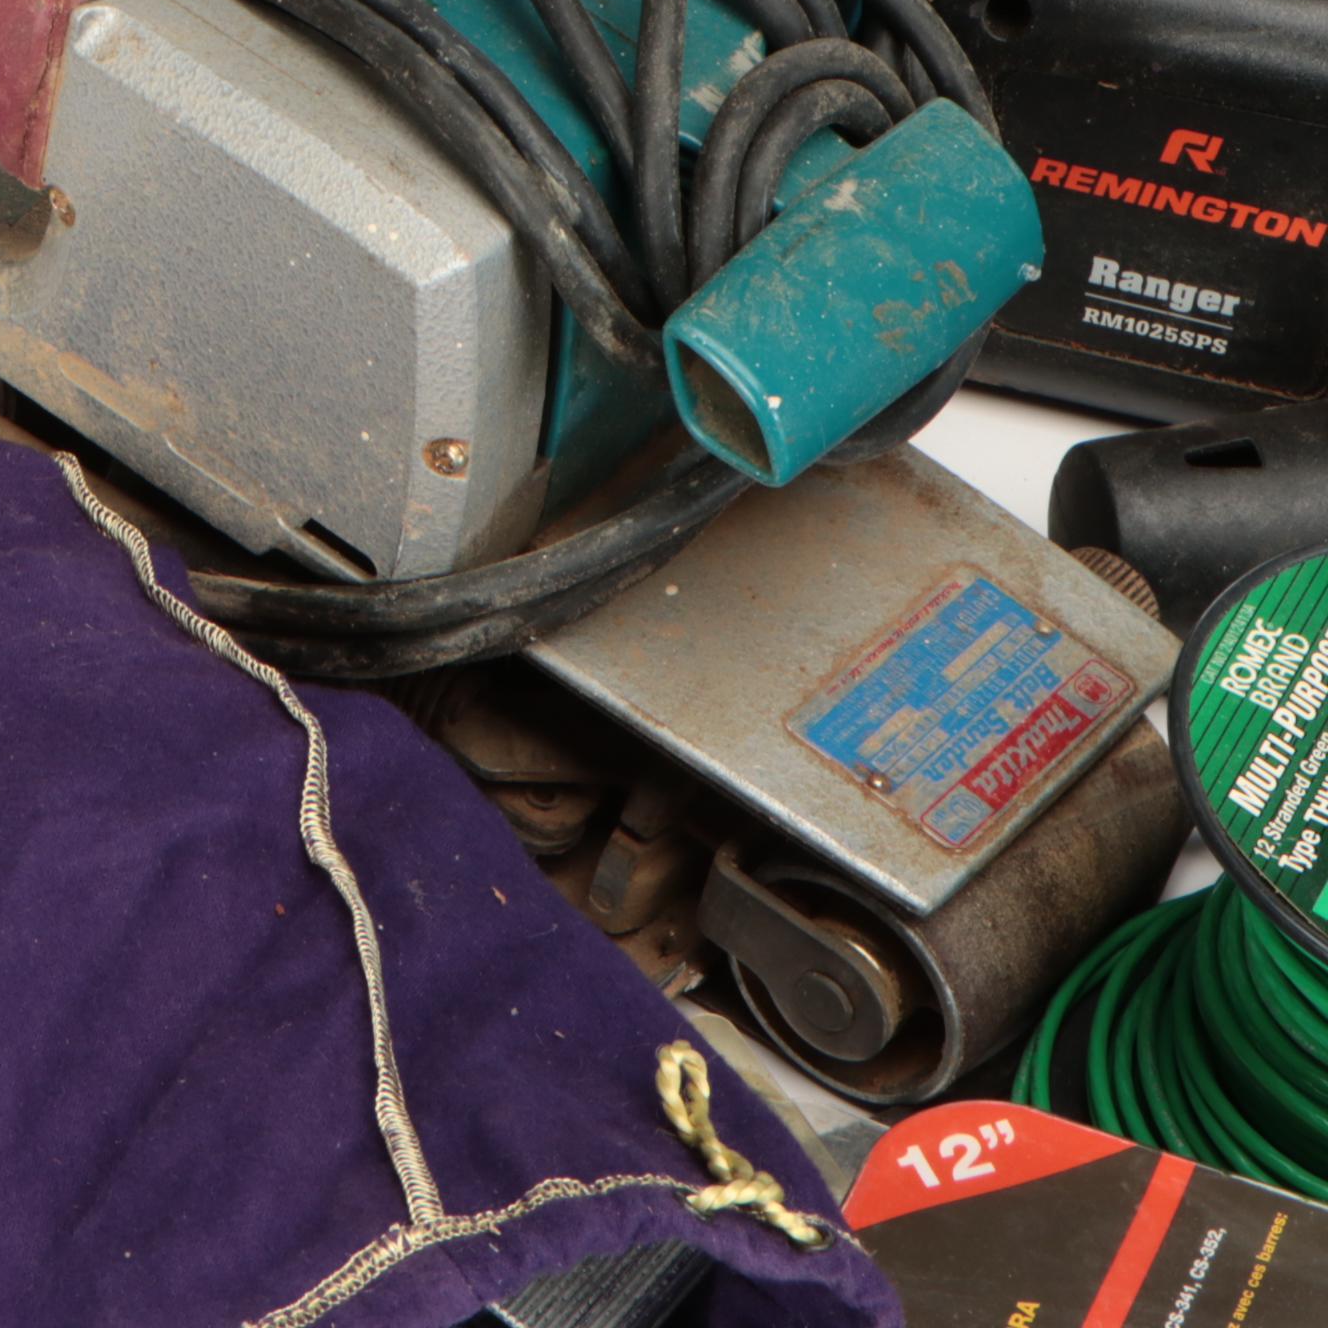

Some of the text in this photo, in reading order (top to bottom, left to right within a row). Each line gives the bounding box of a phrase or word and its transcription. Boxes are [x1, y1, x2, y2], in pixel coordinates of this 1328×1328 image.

[1029, 156, 1328, 248] REMINGTON
[1087, 255, 1241, 317] Ranger
[1081, 305, 1229, 356] RM1025SPS
[1219, 617, 1284, 699] ROMEX
[1249, 632, 1311, 713] BRAND
[1262, 772, 1311, 844] Stranded
[1253, 838, 1278, 863] 12
[1277, 828, 1323, 874] Type
[1188, 1227, 1228, 1281] CS-352,
[1255, 1211, 1289, 1263] barres:
[1247, 1263, 1267, 1289] ces
[1232, 1289, 1255, 1322] avec
